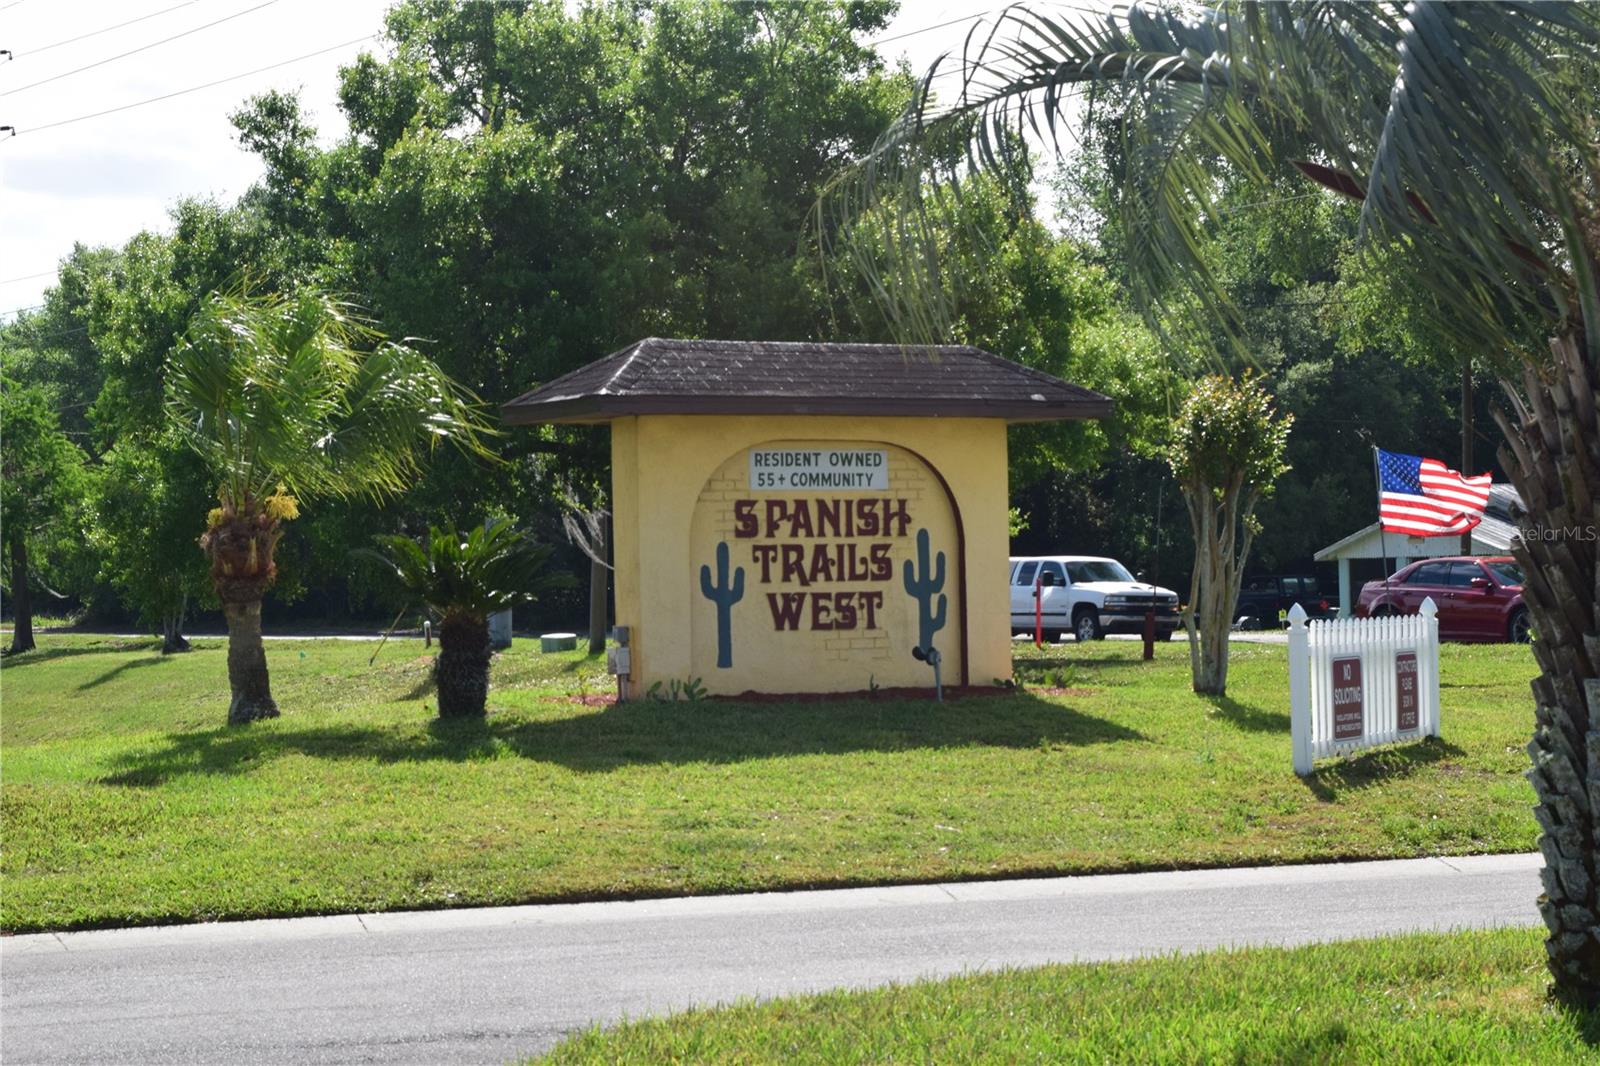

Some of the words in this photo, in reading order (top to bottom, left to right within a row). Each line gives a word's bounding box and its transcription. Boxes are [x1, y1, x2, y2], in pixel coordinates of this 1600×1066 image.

[754, 452, 821, 467] RESIDENT
[829, 452, 882, 467] OWNED
[758, 472, 786, 487] 55+
[790, 472, 874, 487] COMMUNITY
[734, 498, 912, 538] SPANISH
[752, 543, 893, 587] TRAILS
[766, 591, 883, 631] WEST
[1343, 664, 1351, 681] NO
